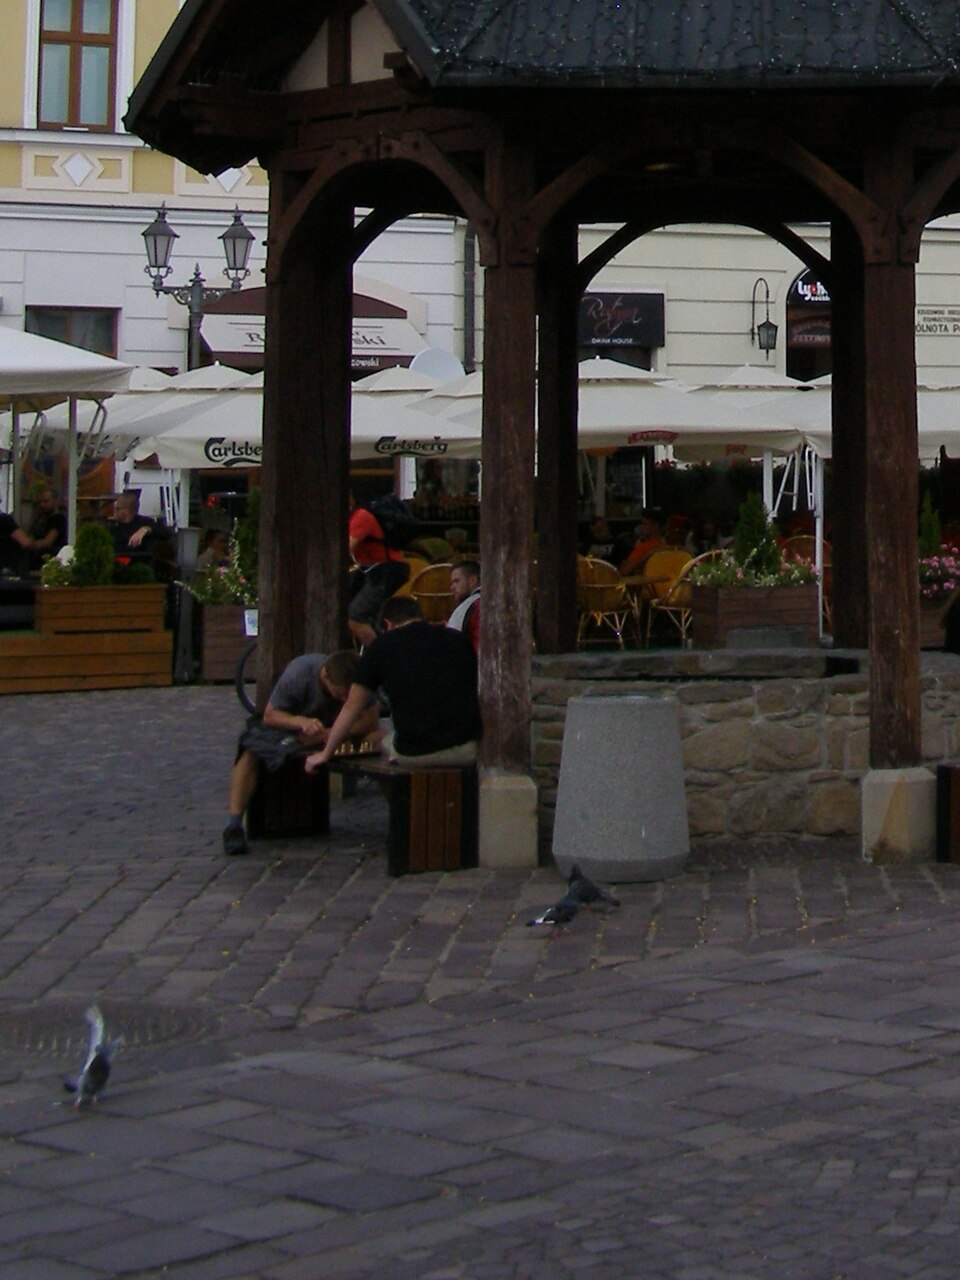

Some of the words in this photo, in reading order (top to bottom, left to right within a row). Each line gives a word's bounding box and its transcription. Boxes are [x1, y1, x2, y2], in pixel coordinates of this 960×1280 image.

[916, 322, 949, 333] ÓLNOTA
[204, 437, 262, 464] Carlsbe
[375, 436, 448, 456] Carlsberg
